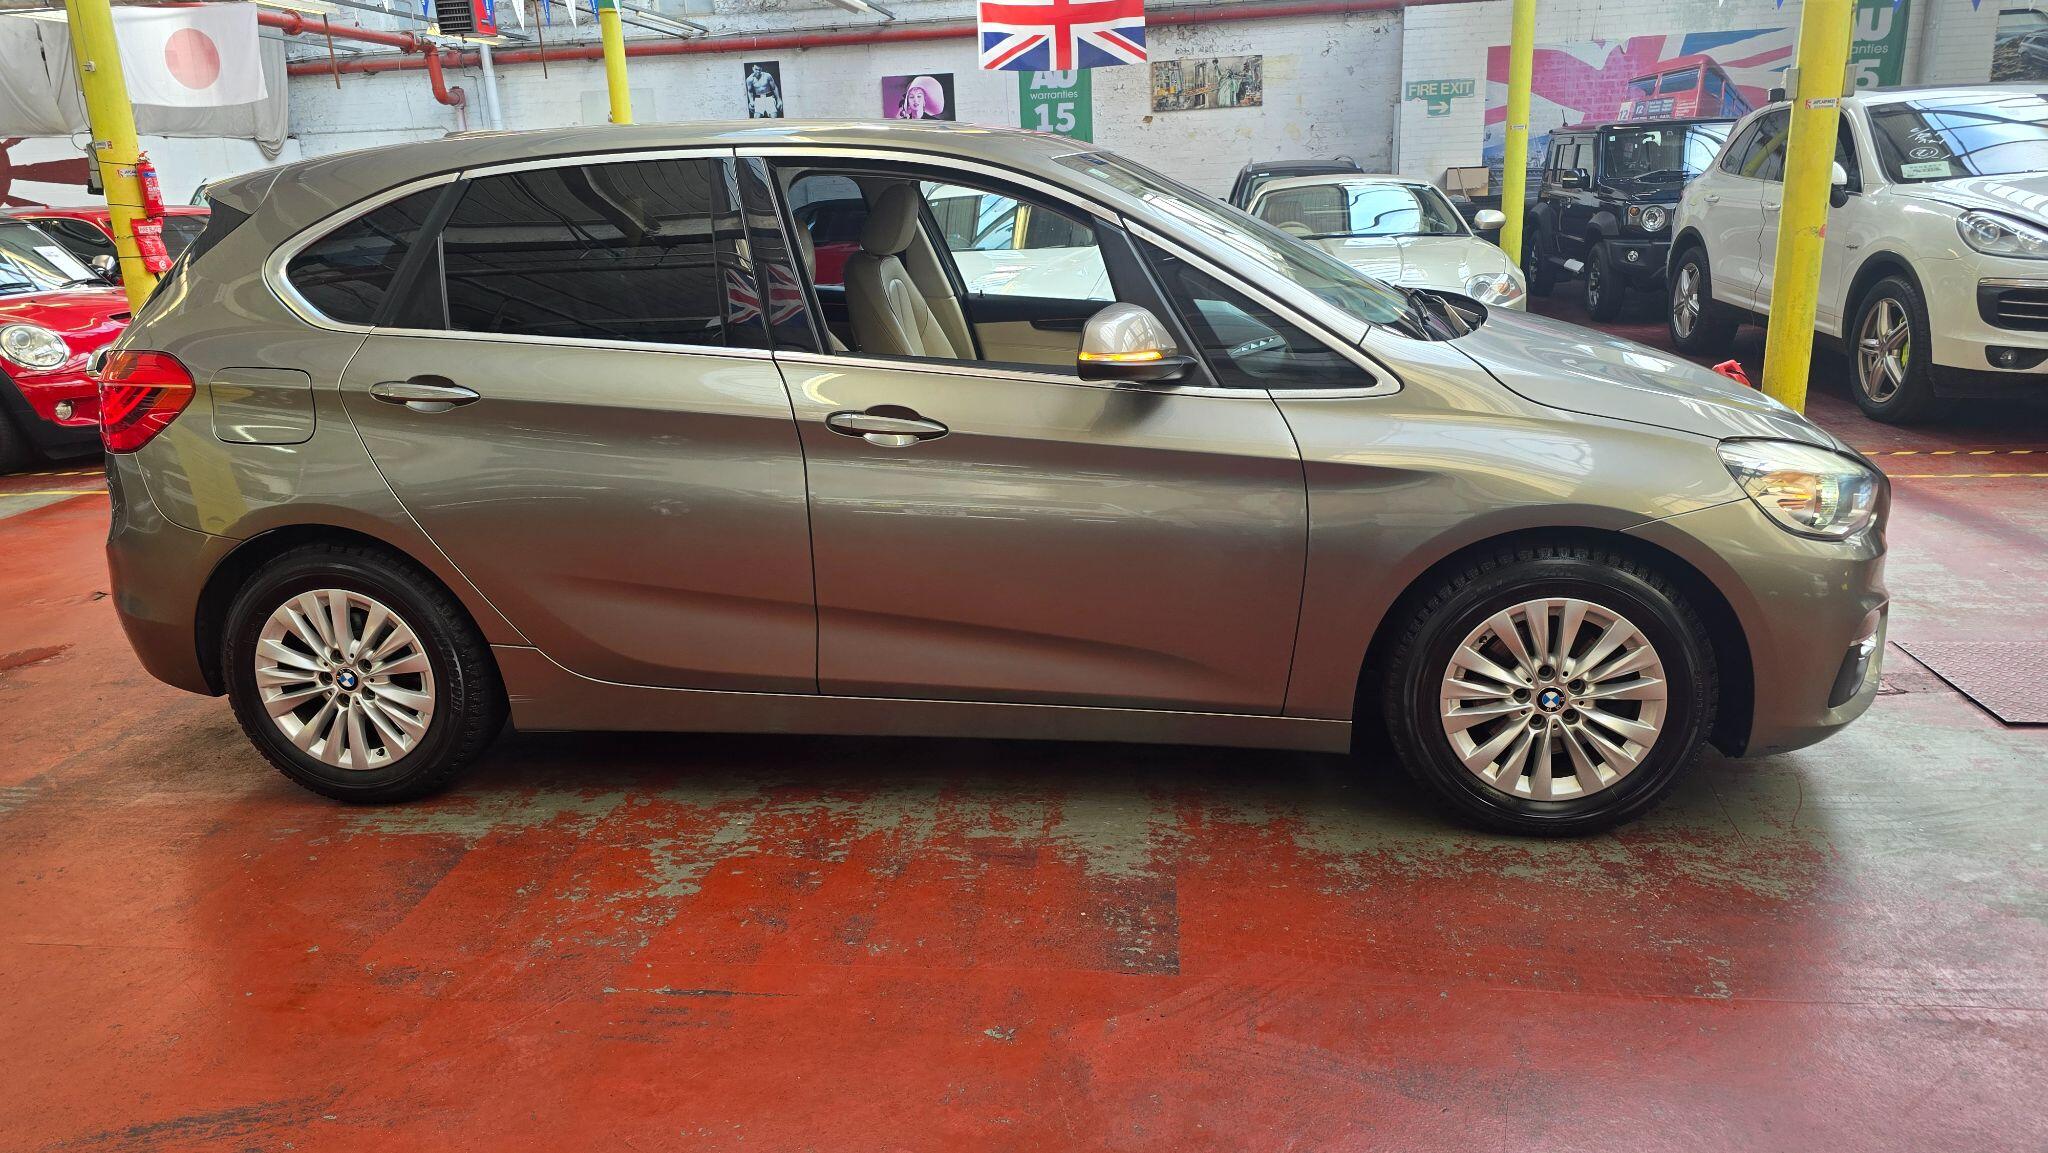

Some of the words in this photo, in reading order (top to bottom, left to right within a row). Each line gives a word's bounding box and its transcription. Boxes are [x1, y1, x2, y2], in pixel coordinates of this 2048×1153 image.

[1853, 7, 1893, 41] U
[1850, 43, 1889, 55] anties
[1855, 58, 1881, 88] 5
[1030, 89, 1079, 100] warranties
[1408, 83, 1438, 97] FIRE
[1440, 80, 1473, 95] EXIT
[1034, 102, 1076, 132] 15
[1635, 105, 1644, 115] 12
